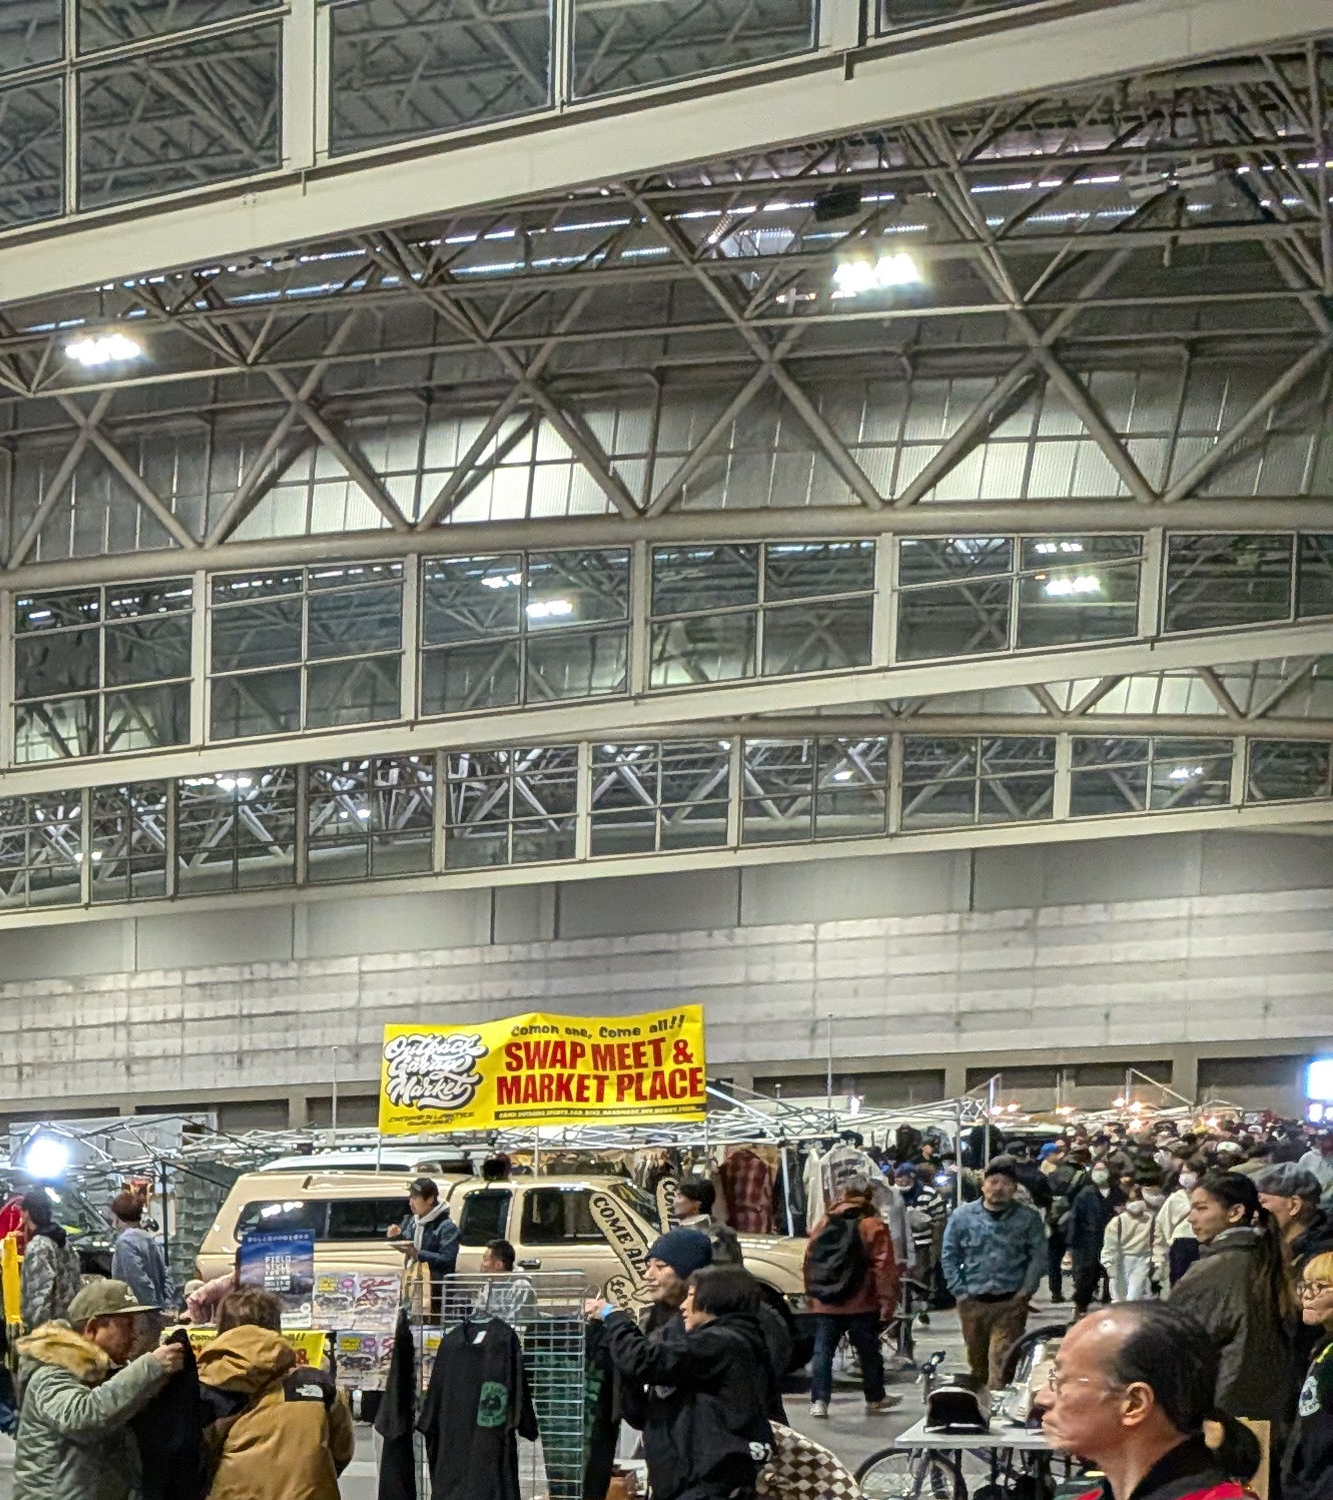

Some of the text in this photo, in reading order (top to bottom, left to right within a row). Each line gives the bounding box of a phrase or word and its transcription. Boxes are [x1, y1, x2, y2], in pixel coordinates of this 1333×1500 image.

[599, 1026, 641, 1038] Come
[649, 1015, 686, 1033] all!!
[504, 1037, 693, 1072] SWAP MEET &
[386, 1071, 483, 1110] Market
[497, 1067, 705, 1105] MARKET PLACE
[593, 1197, 634, 1244] COME
